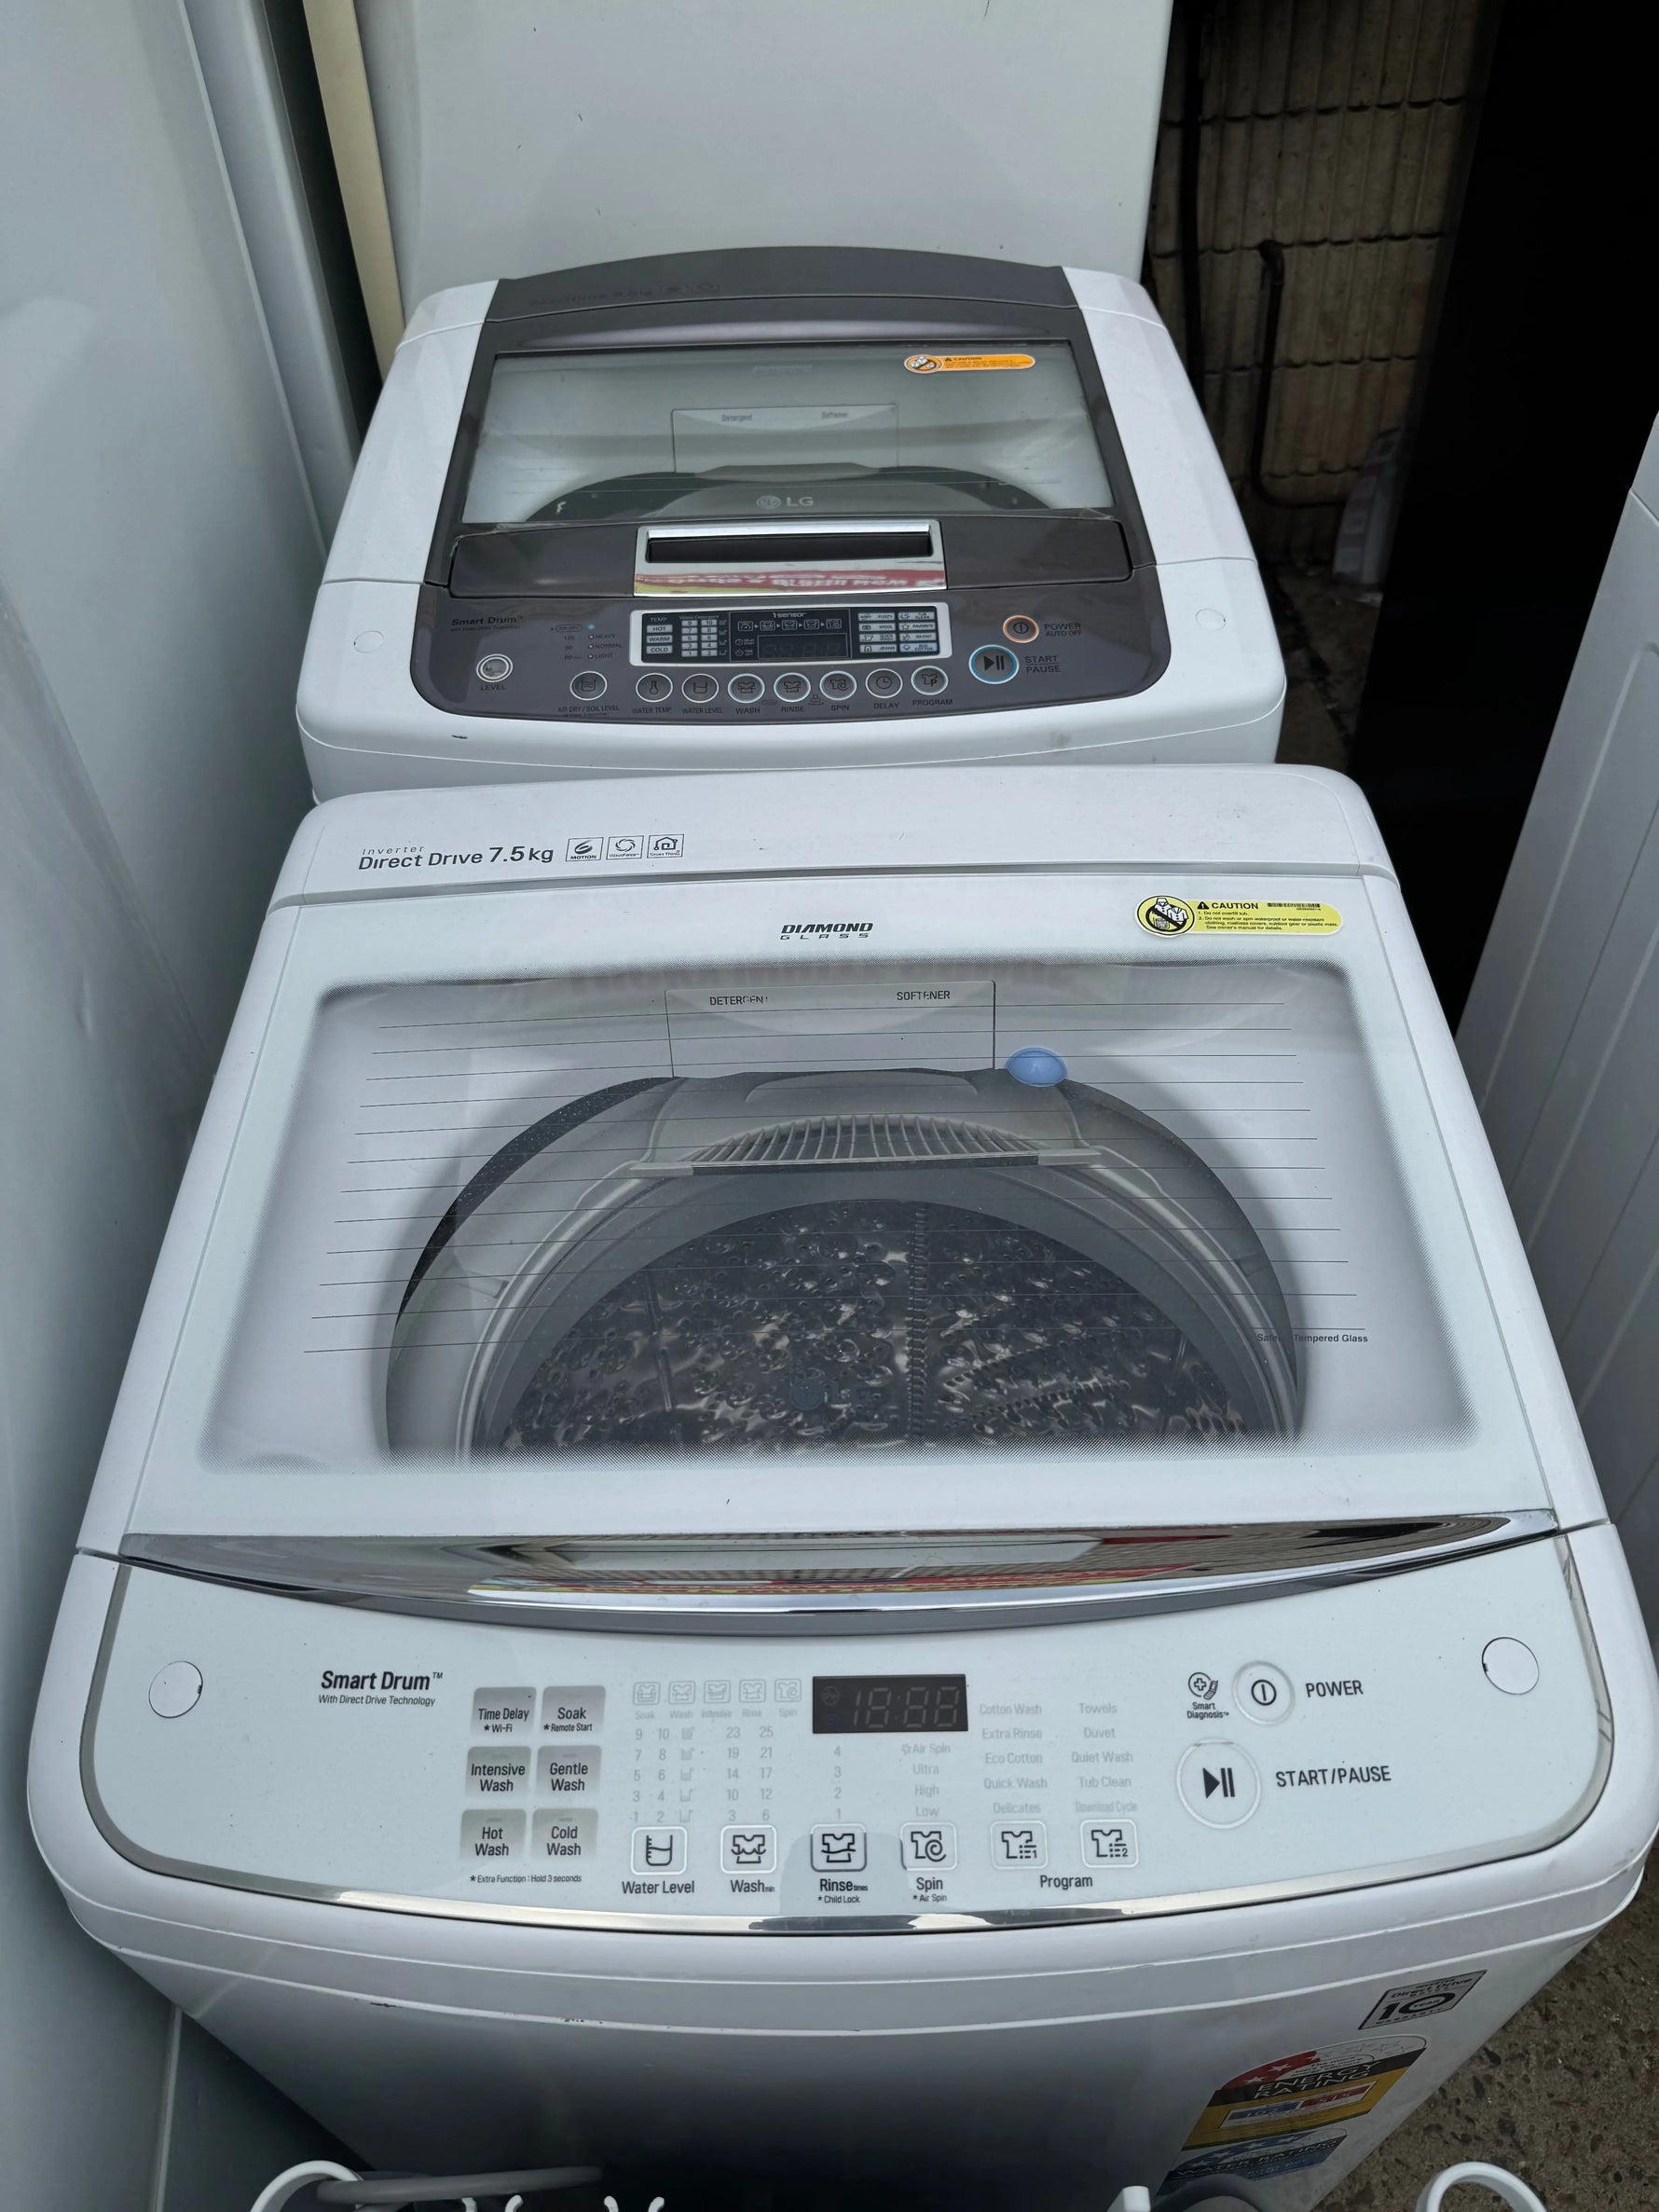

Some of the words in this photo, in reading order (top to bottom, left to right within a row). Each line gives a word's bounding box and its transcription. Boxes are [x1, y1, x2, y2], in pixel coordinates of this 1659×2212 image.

[787, 496, 814, 507] LG
[452, 618, 485, 626] Smart
[1044, 623, 1081, 631] POWER
[363, 845, 425, 855] Inverter
[359, 854, 422, 871] Direct
[428, 852, 483, 867] Drive
[781, 923, 874, 934] DIAMOND
[1294, 1334, 1339, 1343] Tempered
[1341, 1334, 1368, 1342] Glass
[321, 1670, 377, 1690] Smart
[1306, 1680, 1364, 1697] POWER
[319, 1695, 337, 1704] With
[339, 1695, 364, 1704] Direct
[365, 1696, 387, 1705] Drive
[389, 1696, 435, 1707] Technology
[1192, 1701, 1215, 1711] Smart
[557, 1707, 587, 1720] Soak
[669, 1710, 693, 1719] Wash
[778, 1708, 798, 1718] Spin
[980, 1703, 1012, 1715] Cotton
[1013, 1703, 1042, 1715] Wash
[1079, 1702, 1118, 1714] Towels
[478, 1708, 500, 1721] Time
[502, 1708, 529, 1722] Delay
[635, 1711, 655, 1720] Soak
[551, 1724, 575, 1732] Remote
[576, 1723, 593, 1732] Start
[636, 1728, 643, 1740] 9
[658, 1727, 670, 1740] 10
[726, 1726, 741, 1739] 23
[759, 1725, 774, 1738] 25
[982, 1728, 1011, 1739] Extra
[1013, 1727, 1042, 1739] Rinse
[1083, 1726, 1116, 1738] Duvet
[635, 1749, 642, 1761] 7
[658, 1748, 666, 1761] 8
[727, 1747, 740, 1759] 19
[760, 1746, 773, 1759] 21
[834, 1745, 841, 1756] 4
[912, 1743, 925, 1753] Air
[929, 1743, 951, 1754] Spin
[985, 1752, 1005, 1765] Eco
[1007, 1752, 1043, 1765] Cotton
[1071, 1751, 1100, 1765] Quiet
[1103, 1751, 1133, 1763] Wash
[471, 1763, 526, 1776] Intensive
[550, 1762, 588, 1775] Gentle
[634, 1769, 640, 1781] 5
[658, 1768, 665, 1781] 6
[727, 1767, 739, 1779] 14
[761, 1766, 773, 1779] 17
[834, 1765, 842, 1779] 3
[912, 1765, 939, 1775] Ultra
[1078, 1776, 1100, 1788] Tub
[1100, 1776, 1131, 1788] Clean
[1276, 1765, 1392, 1787] START/PAUSE
[479, 1779, 514, 1792] Wash
[551, 1779, 585, 1792] Wash
[983, 1778, 1014, 1790] Quick
[1017, 1777, 1048, 1789] Wash
[633, 1790, 640, 1803] 3
[657, 1790, 665, 1802] 4
[727, 1789, 739, 1801] 10
[761, 1788, 773, 1801] 12
[834, 1787, 842, 1799] 2
[914, 1785, 939, 1797] High
[762, 1808, 770, 1821] 6
[915, 1806, 939, 1817] Low
[993, 1802, 1041, 1814] Delicates
[656, 1810, 665, 1822] 2
[729, 1809, 736, 1822] 3
[481, 1826, 503, 1840] Hot
[551, 1826, 578, 1839] Cold
[474, 1843, 510, 1856] Wash
[546, 1843, 582, 1856] Wash
[477, 1875, 495, 1883] Extra
[497, 1875, 526, 1883] Function
[530, 1875, 547, 1883] Hold
[553, 1875, 582, 1883] seconds
[916, 1877, 943, 1891] Spin
[1039, 1875, 1093, 1890] Program
[622, 1880, 659, 1894] Water
[663, 1880, 695, 1893] Level
[824, 1895, 843, 1903] Child
[843, 1895, 860, 1903] Lock
[919, 1893, 929, 1903] Air
[931, 1893, 947, 1903] Spin
[1391, 1985, 1432, 1999] Direct
[1435, 1977, 1474, 1989] Drive
[1378, 1992, 1456, 2021] 10
[1257, 2060, 1382, 2092] ENERGY
[1254, 2073, 1369, 2099] RATING
